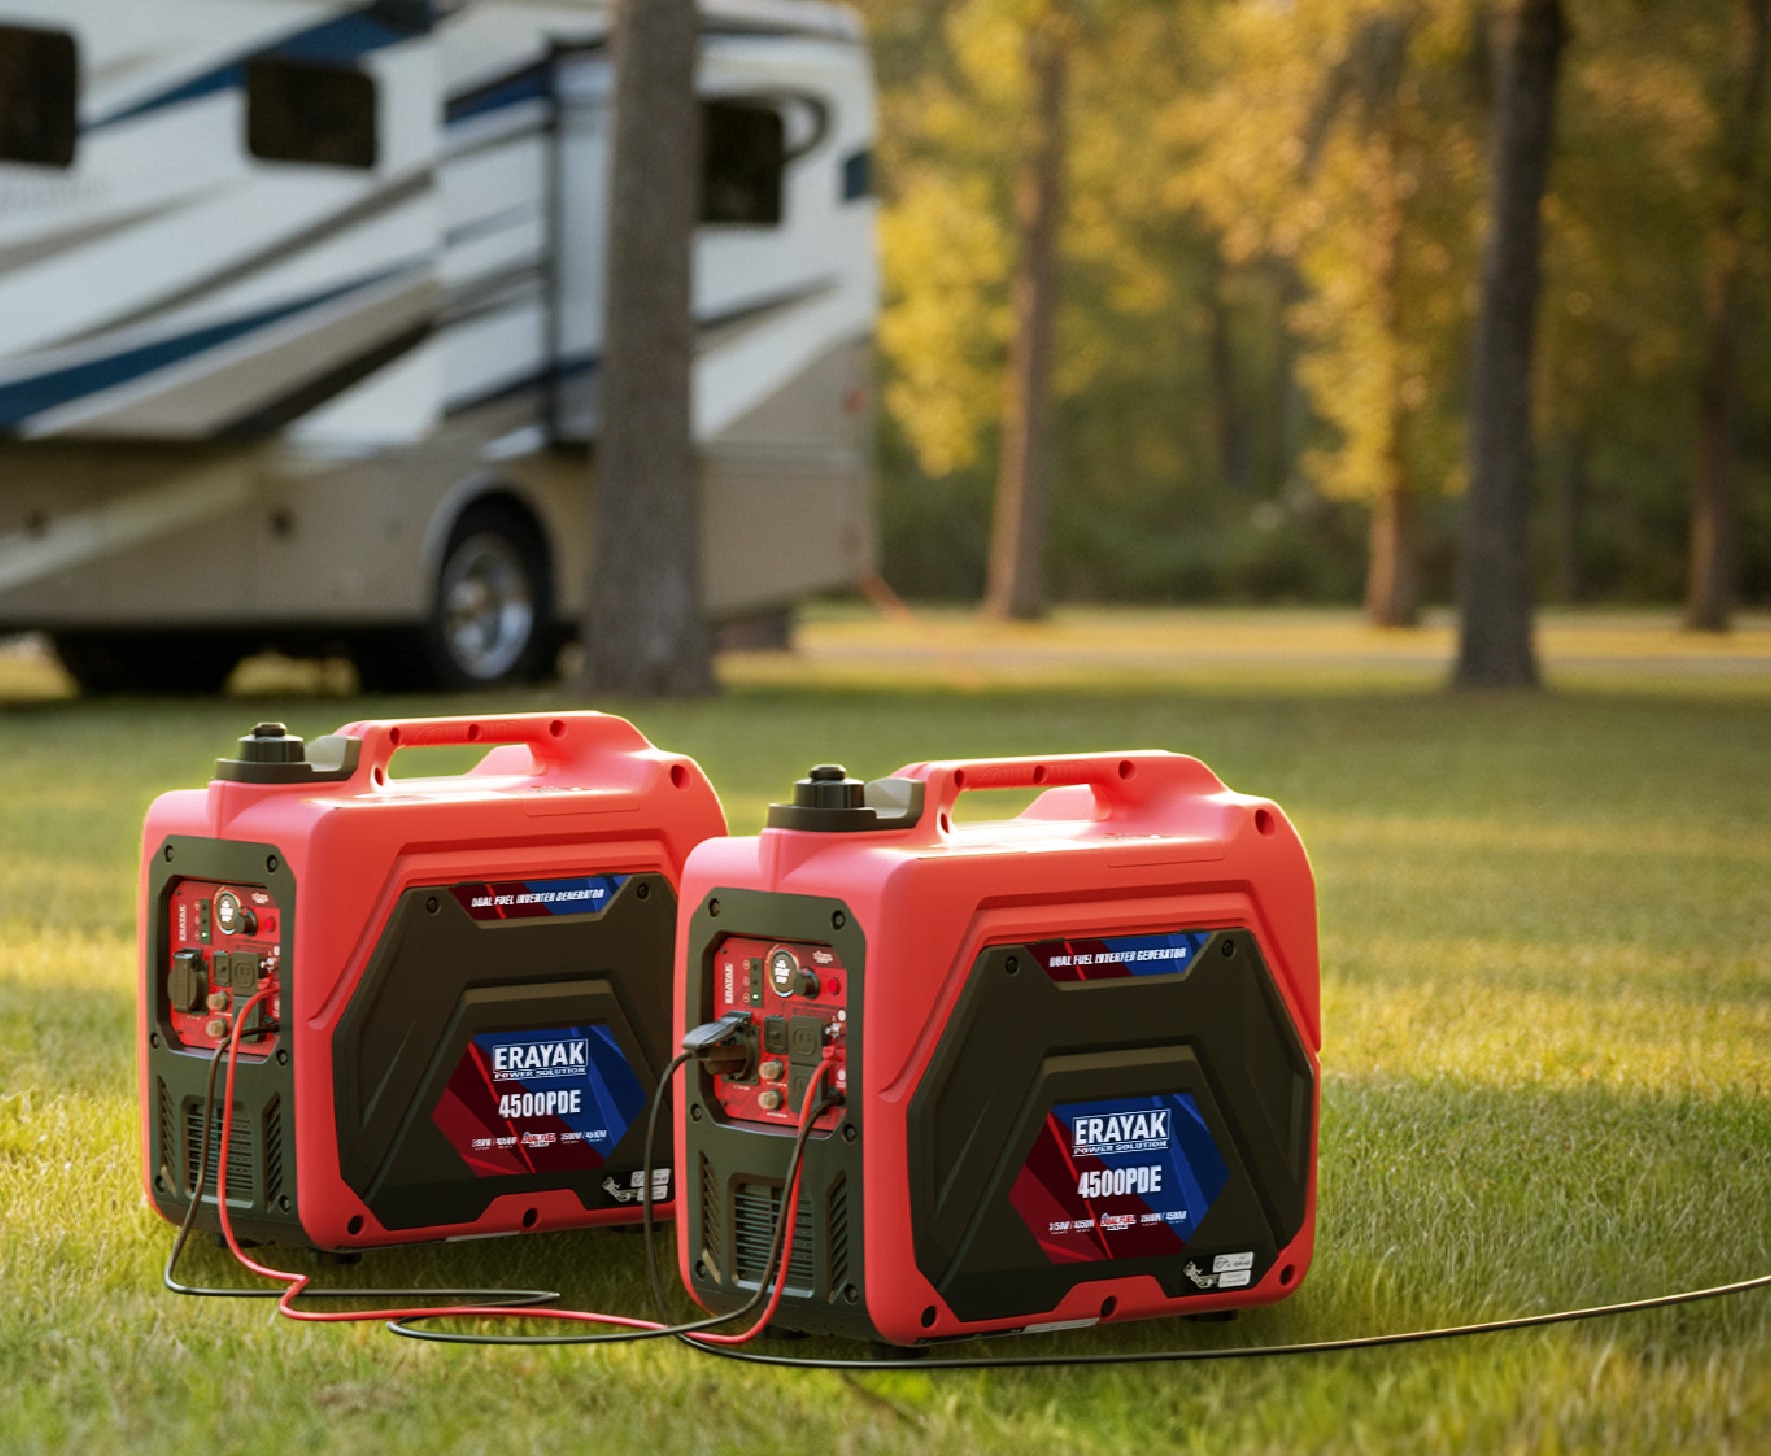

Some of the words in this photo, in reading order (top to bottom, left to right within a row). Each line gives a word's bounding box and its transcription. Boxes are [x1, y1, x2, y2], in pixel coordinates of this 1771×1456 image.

[1050, 956, 1072, 967] DUAL
[1073, 954, 1092, 965] FUEL
[1095, 951, 1136, 964] INVERTER
[1137, 947, 1187, 961] GENERATOR
[494, 1041, 585, 1070] ERAYAK
[498, 1089, 581, 1118] 4500PDE
[1075, 1112, 1166, 1145] ERAYAK
[1074, 1145, 1113, 1155] POWER
[1077, 1165, 1162, 1199] 4500PDE
